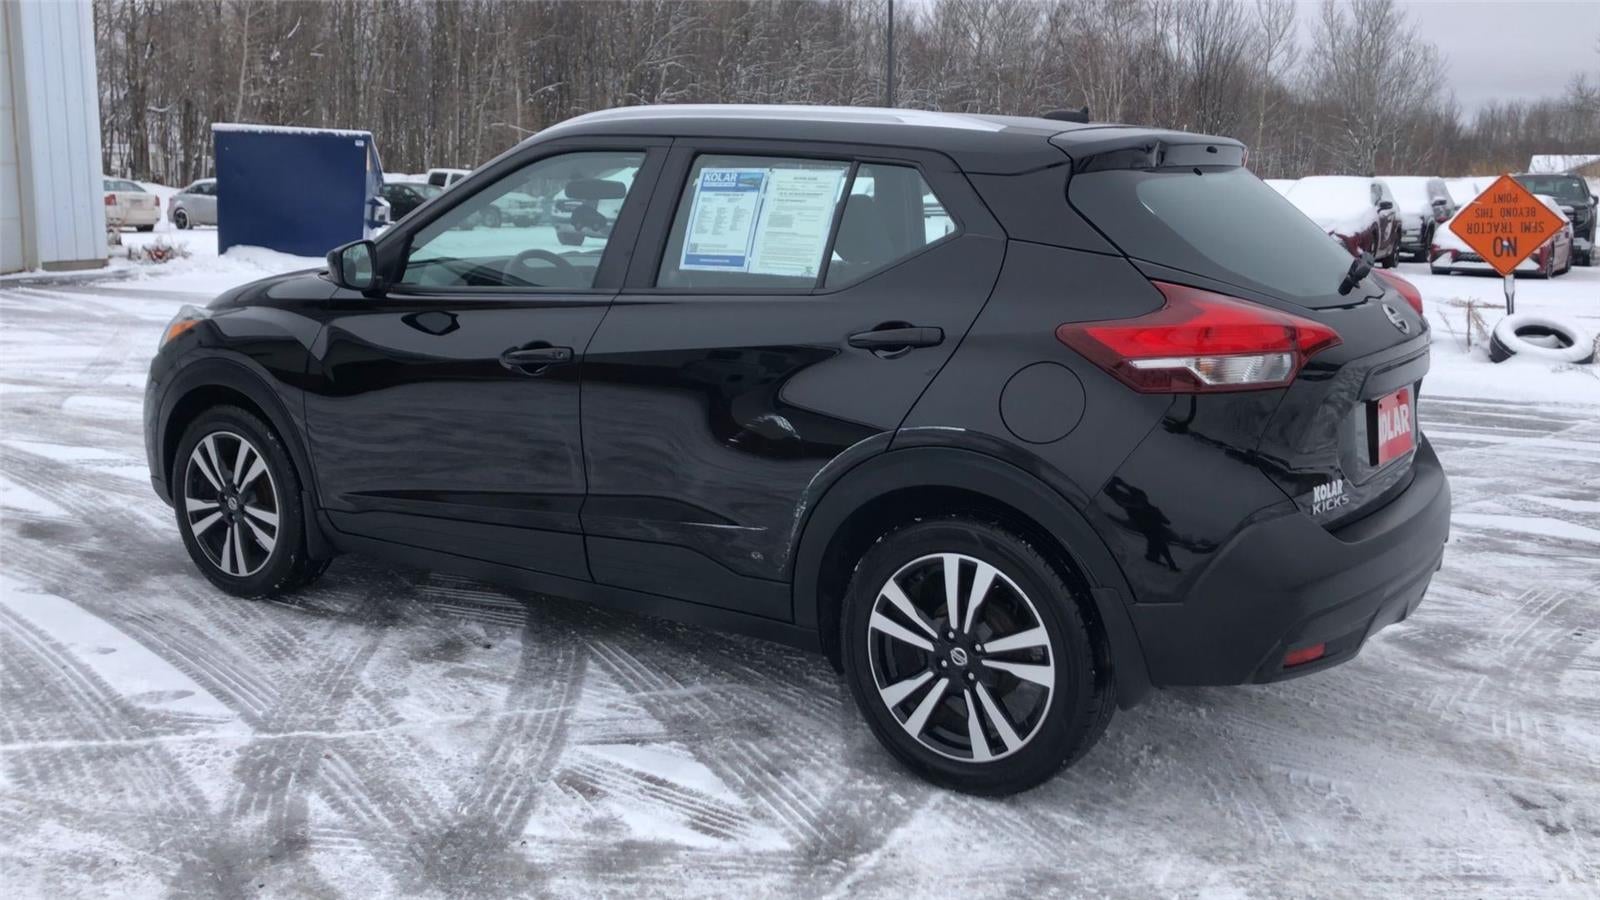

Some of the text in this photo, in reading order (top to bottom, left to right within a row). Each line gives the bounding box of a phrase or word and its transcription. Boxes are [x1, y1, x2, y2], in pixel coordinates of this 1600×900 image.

[704, 172, 738, 182] KOLAR
[1493, 193, 1519, 204] POINT
[1475, 206, 1536, 218] BEYOND THIS
[1466, 221, 1545, 234] SEMI TRACTOR
[1492, 236, 1518, 257] NO
[1378, 403, 1411, 446] OLAR
[1313, 478, 1343, 503] KOLAR
[1311, 494, 1350, 515] KICKS
